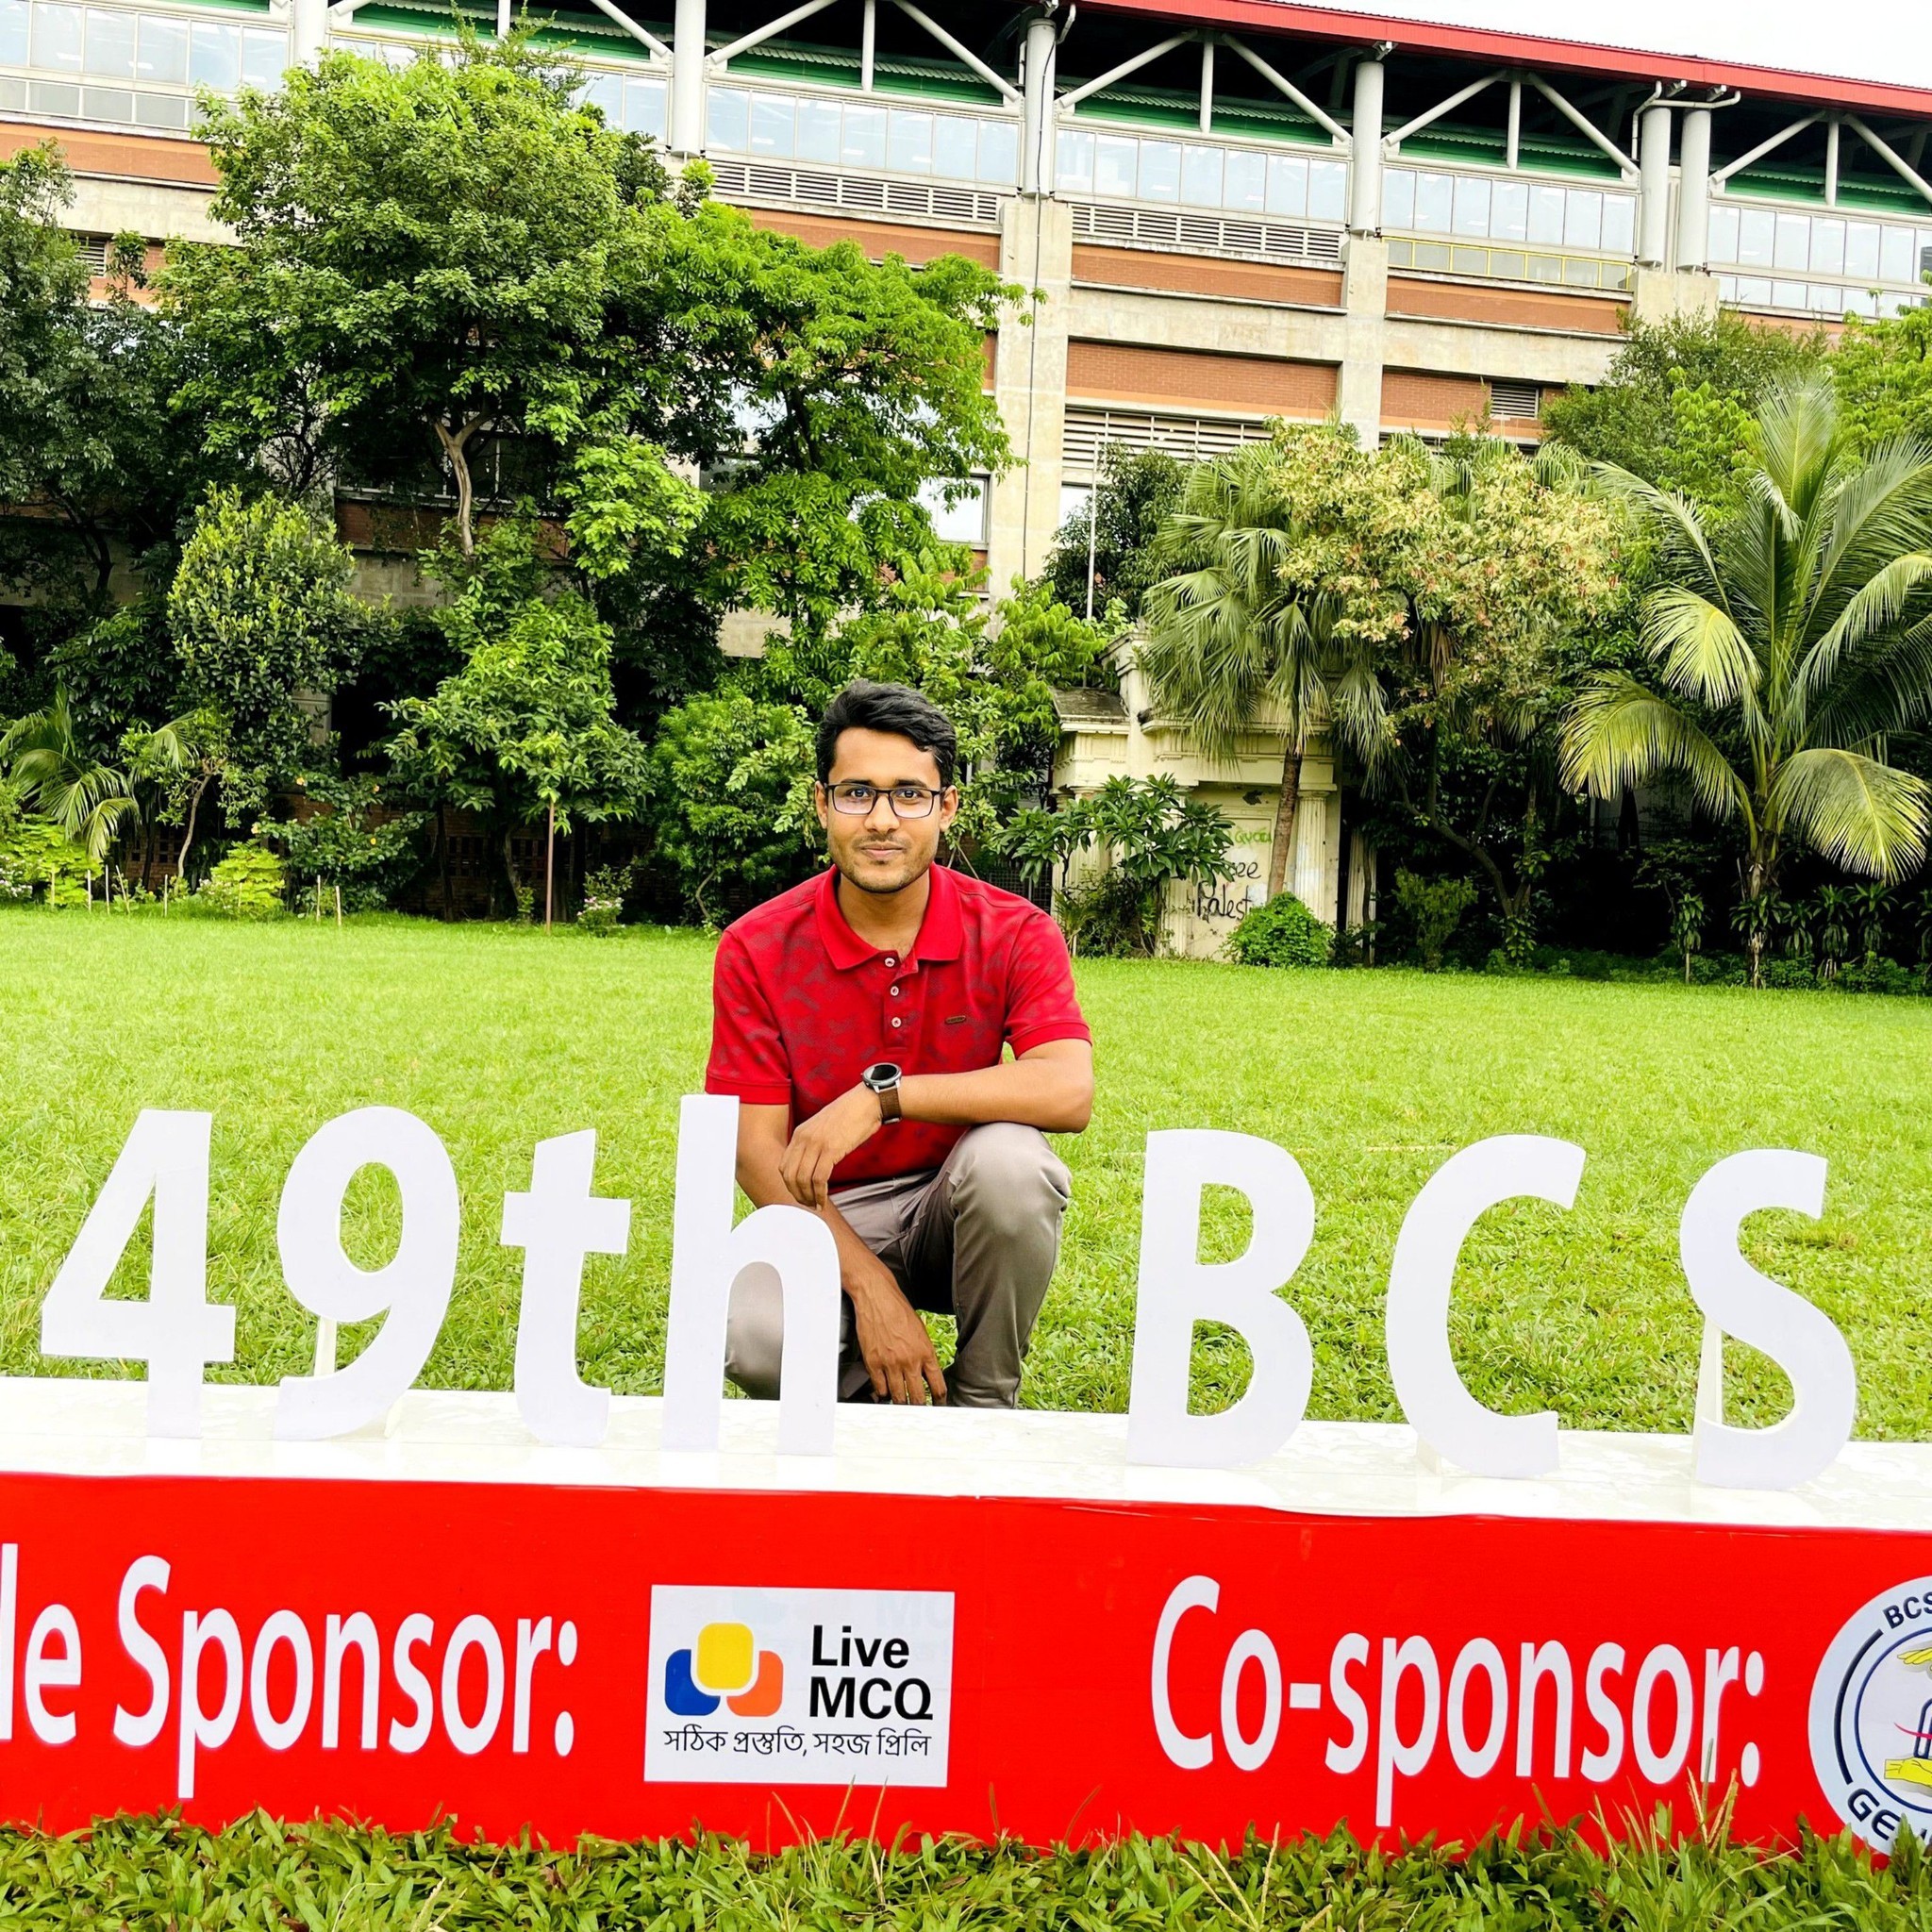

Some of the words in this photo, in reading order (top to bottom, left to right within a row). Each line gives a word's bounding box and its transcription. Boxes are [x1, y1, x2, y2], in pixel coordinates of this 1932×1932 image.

[1197, 880, 1253, 922] Palest
[41, 1094, 841, 1456] 49th
[1127, 1128, 1857, 1490] BCS
[811, 1624, 909, 1669] Live
[0, 1543, 82, 1744] le
[112, 1555, 577, 1799] Sponsor:
[809, 1676, 933, 1721] MCQ
[1151, 1574, 1764, 1826] Co-sponsor:
[663, 1724, 728, 1751] সঠিক
[733, 1725, 807, 1756] প্রস্তুতি,
[812, 1733, 872, 1755] সহজ
[875, 1727, 932, 1756] প্রিলি
[1847, 1788, 1929, 1840] GE
